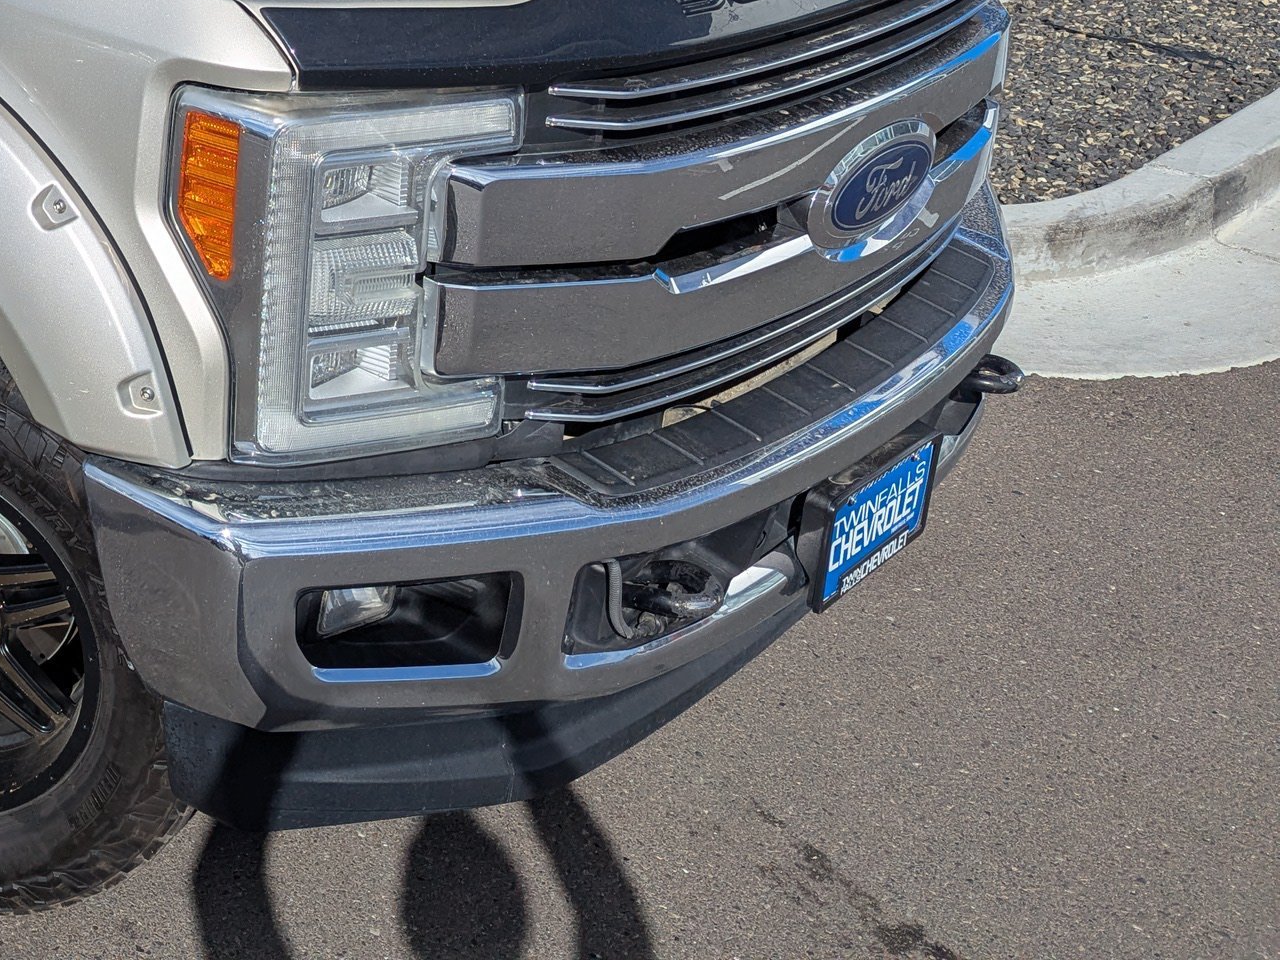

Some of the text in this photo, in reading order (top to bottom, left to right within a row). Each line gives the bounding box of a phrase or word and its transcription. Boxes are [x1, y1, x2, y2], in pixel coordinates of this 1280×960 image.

[855, 156, 919, 220] Ford
[828, 478, 924, 573] CHEVROLET
[860, 529, 909, 579] CHEVROLET
